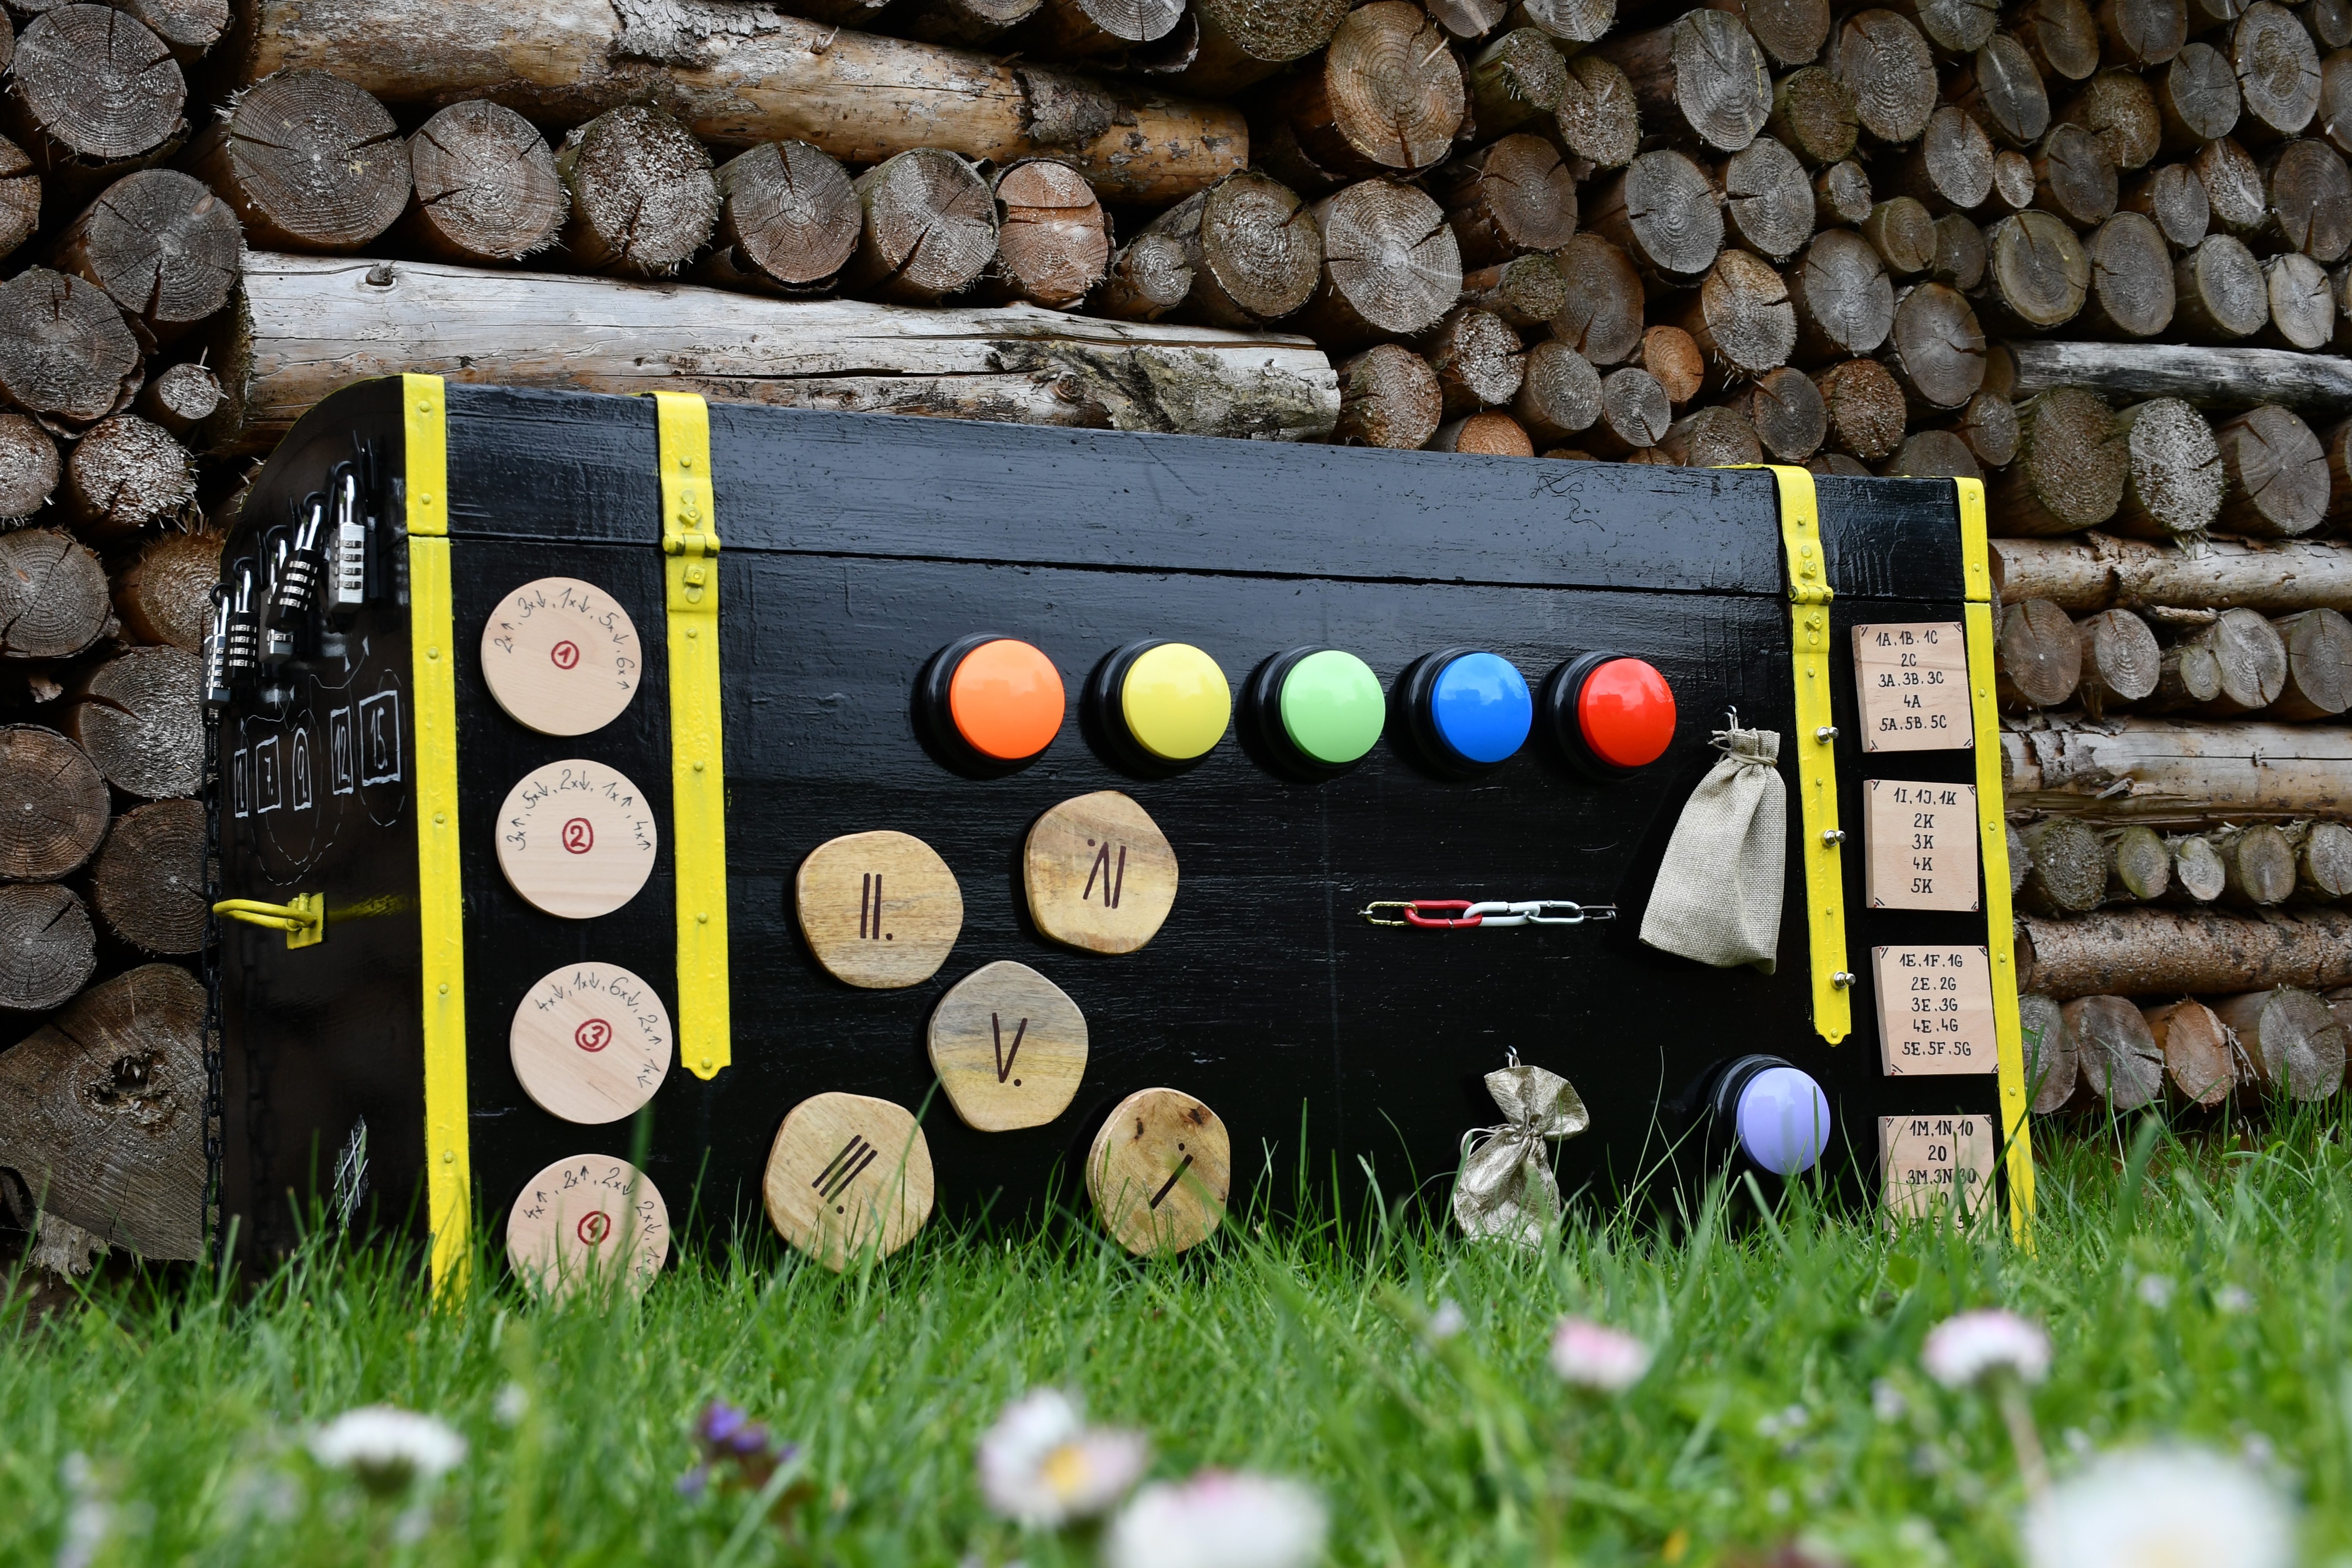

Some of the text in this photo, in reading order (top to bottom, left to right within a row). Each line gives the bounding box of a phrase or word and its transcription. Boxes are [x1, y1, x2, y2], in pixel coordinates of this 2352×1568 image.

[1924, 630, 1938, 644] 1C
[1901, 653, 1916, 667] 2C
[1927, 671, 1944, 684] 3C
[1903, 694, 1922, 708] 4A
[1930, 715, 1947, 729] 5C
[1938, 790, 1957, 805] 1K
[1914, 813, 1934, 828] 2K
[1912, 833, 1933, 849] 3K
[1913, 857, 1933, 871] 4K
[1911, 878, 1933, 893] 5K
[1947, 954, 1963, 967] 1G
[1940, 977, 1956, 991] 2G
[1939, 998, 1958, 1012] 3G
[1941, 1018, 1958, 1032] 4G
[992, 1012, 1028, 1087] V.
[1953, 1042, 1971, 1056] 5G
